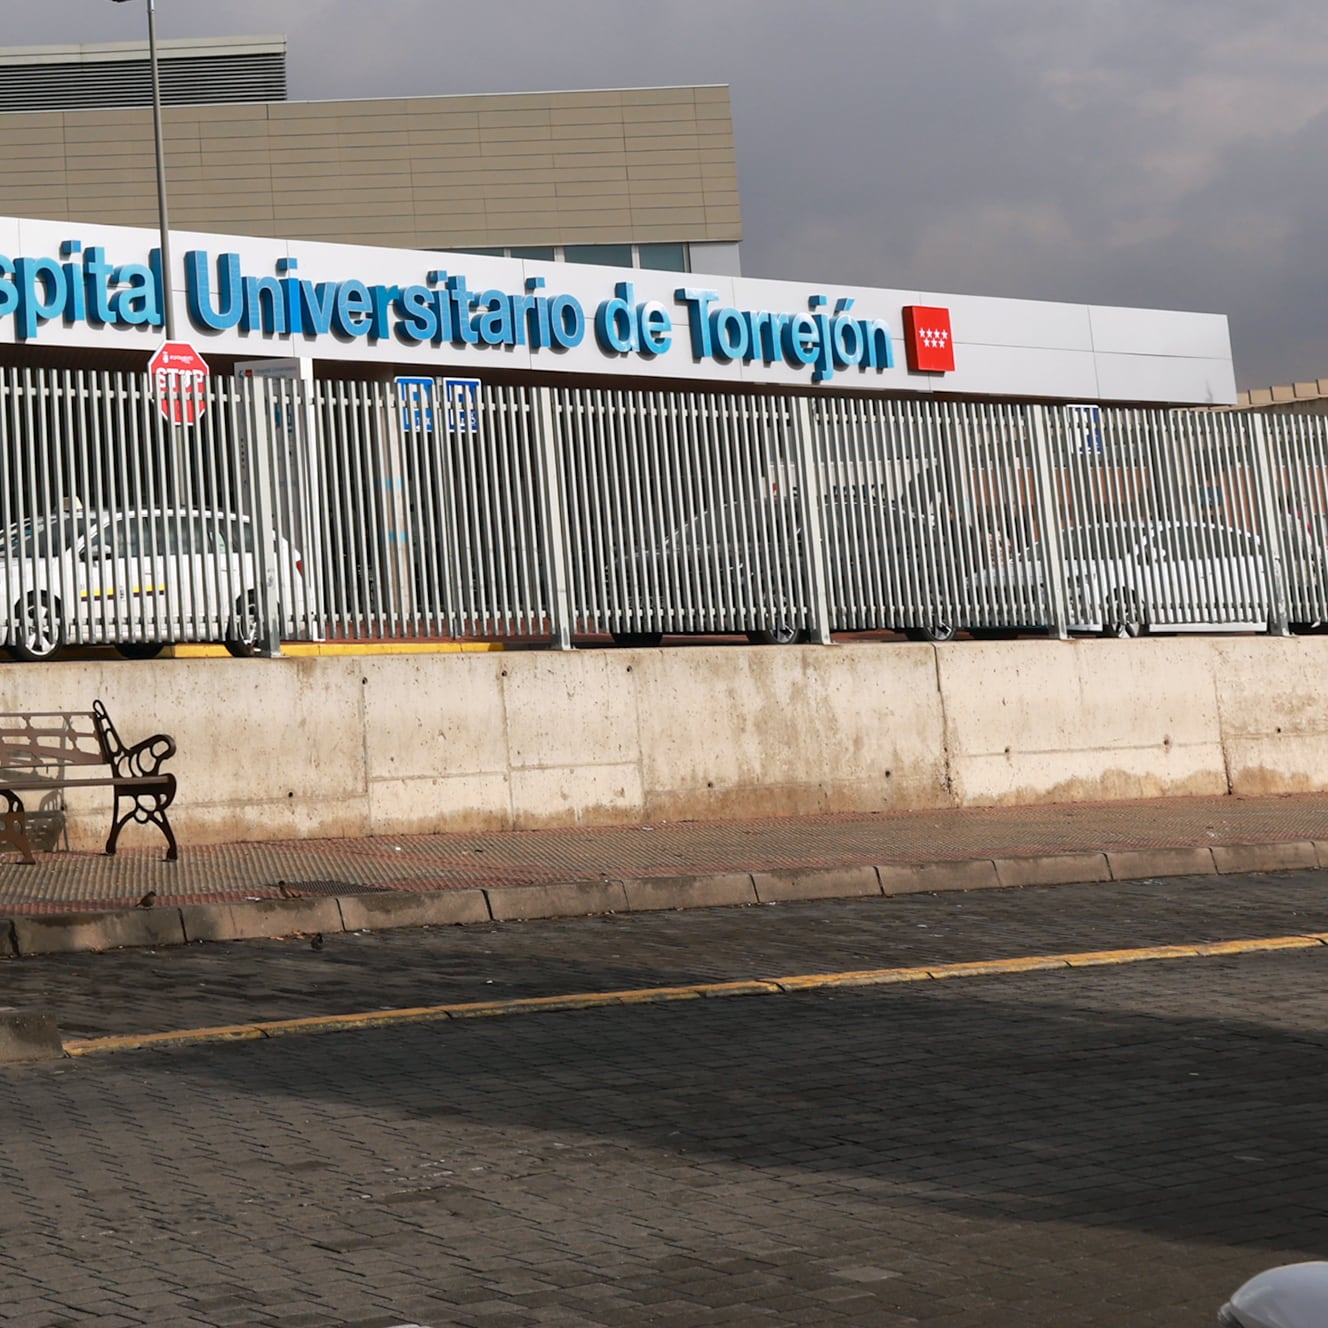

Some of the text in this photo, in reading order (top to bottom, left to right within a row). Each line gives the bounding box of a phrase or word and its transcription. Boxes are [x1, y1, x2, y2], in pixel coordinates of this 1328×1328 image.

[183, 250, 586, 349] Universitario
[594, 282, 672, 355] de
[674, 287, 894, 381] Torrejón
